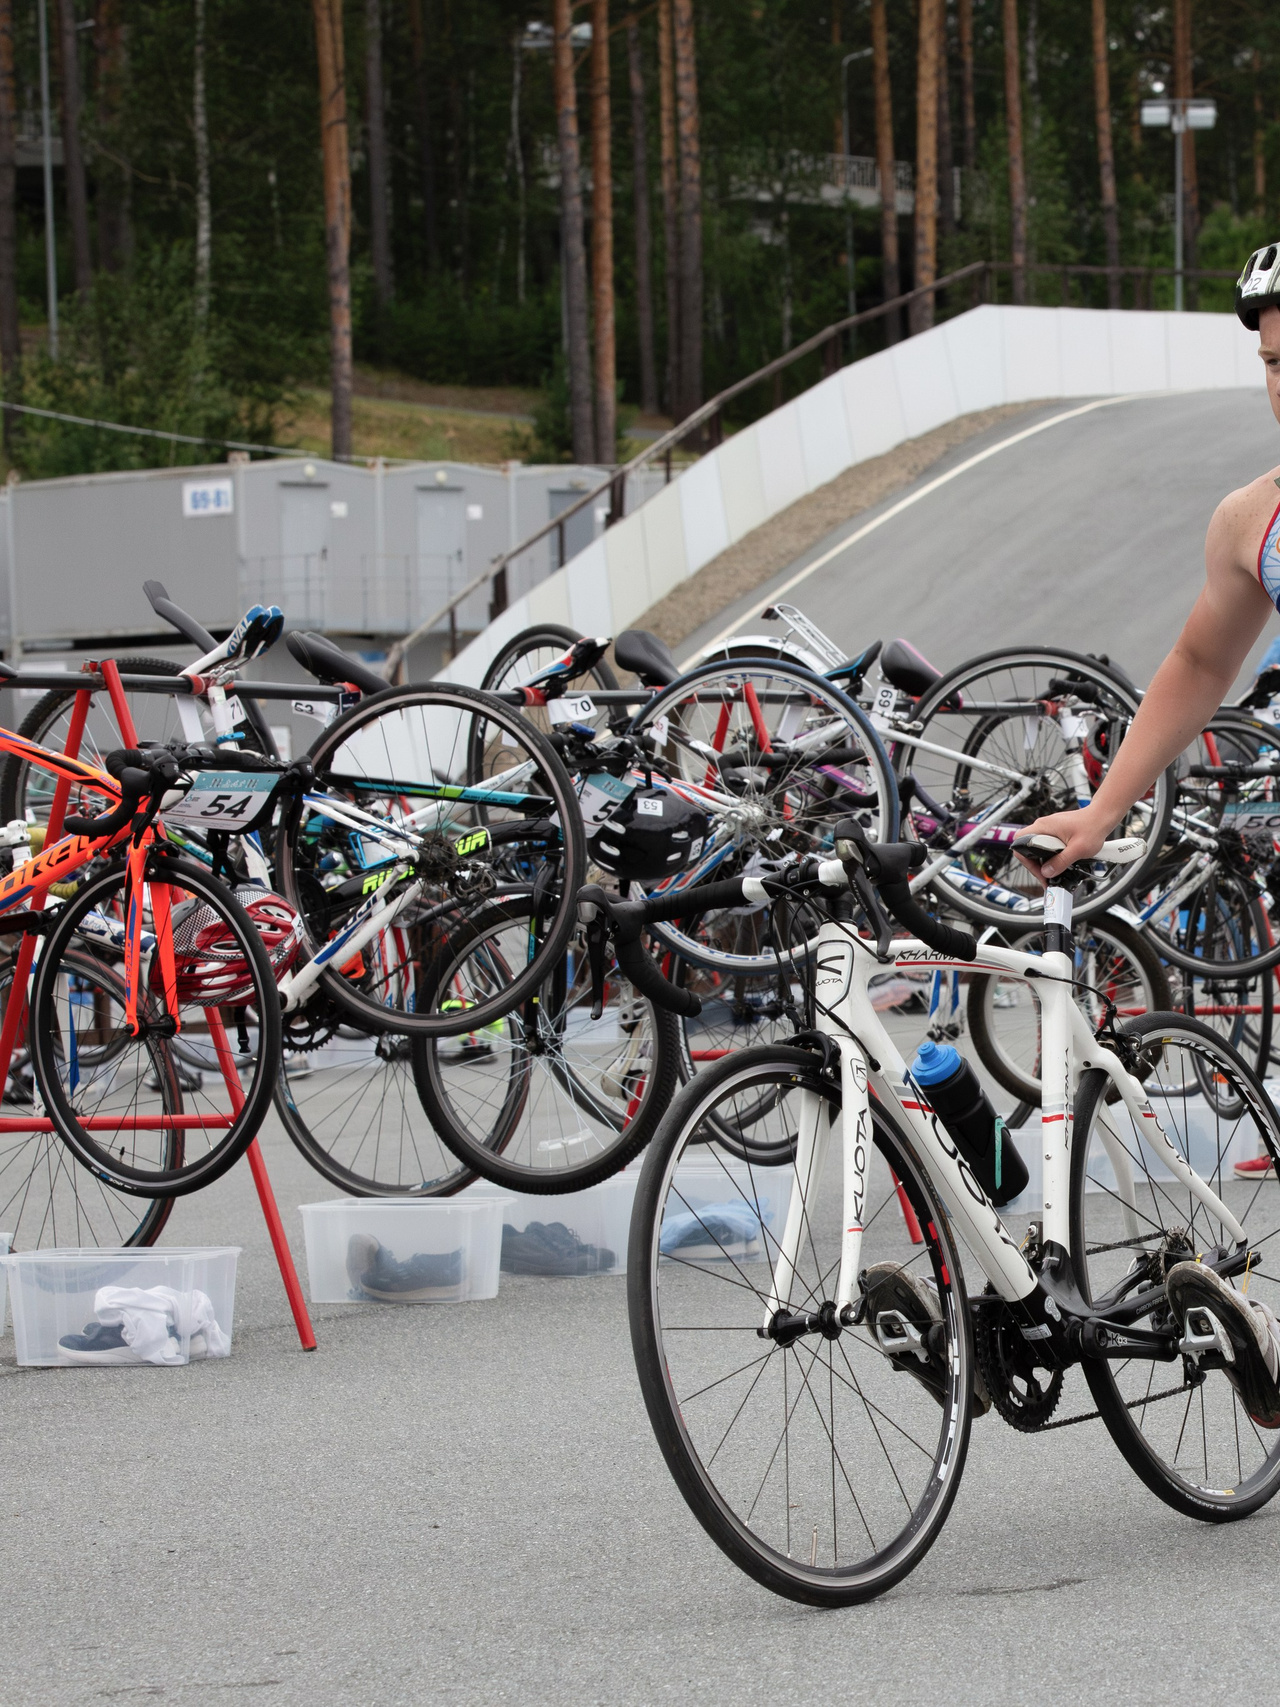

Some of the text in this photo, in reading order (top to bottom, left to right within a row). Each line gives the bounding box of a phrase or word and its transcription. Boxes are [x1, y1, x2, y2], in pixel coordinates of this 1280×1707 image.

[228, 616, 253, 655] OVAL
[570, 699, 592, 717] 70
[877, 689, 894, 708] 69
[229, 703, 243, 720] 71
[200, 794, 253, 819] 54
[592, 799, 620, 823] 5
[643, 800, 658, 811] 53
[1118, 842, 1136, 854] san
[853, 1107, 868, 1227] KUOTA
